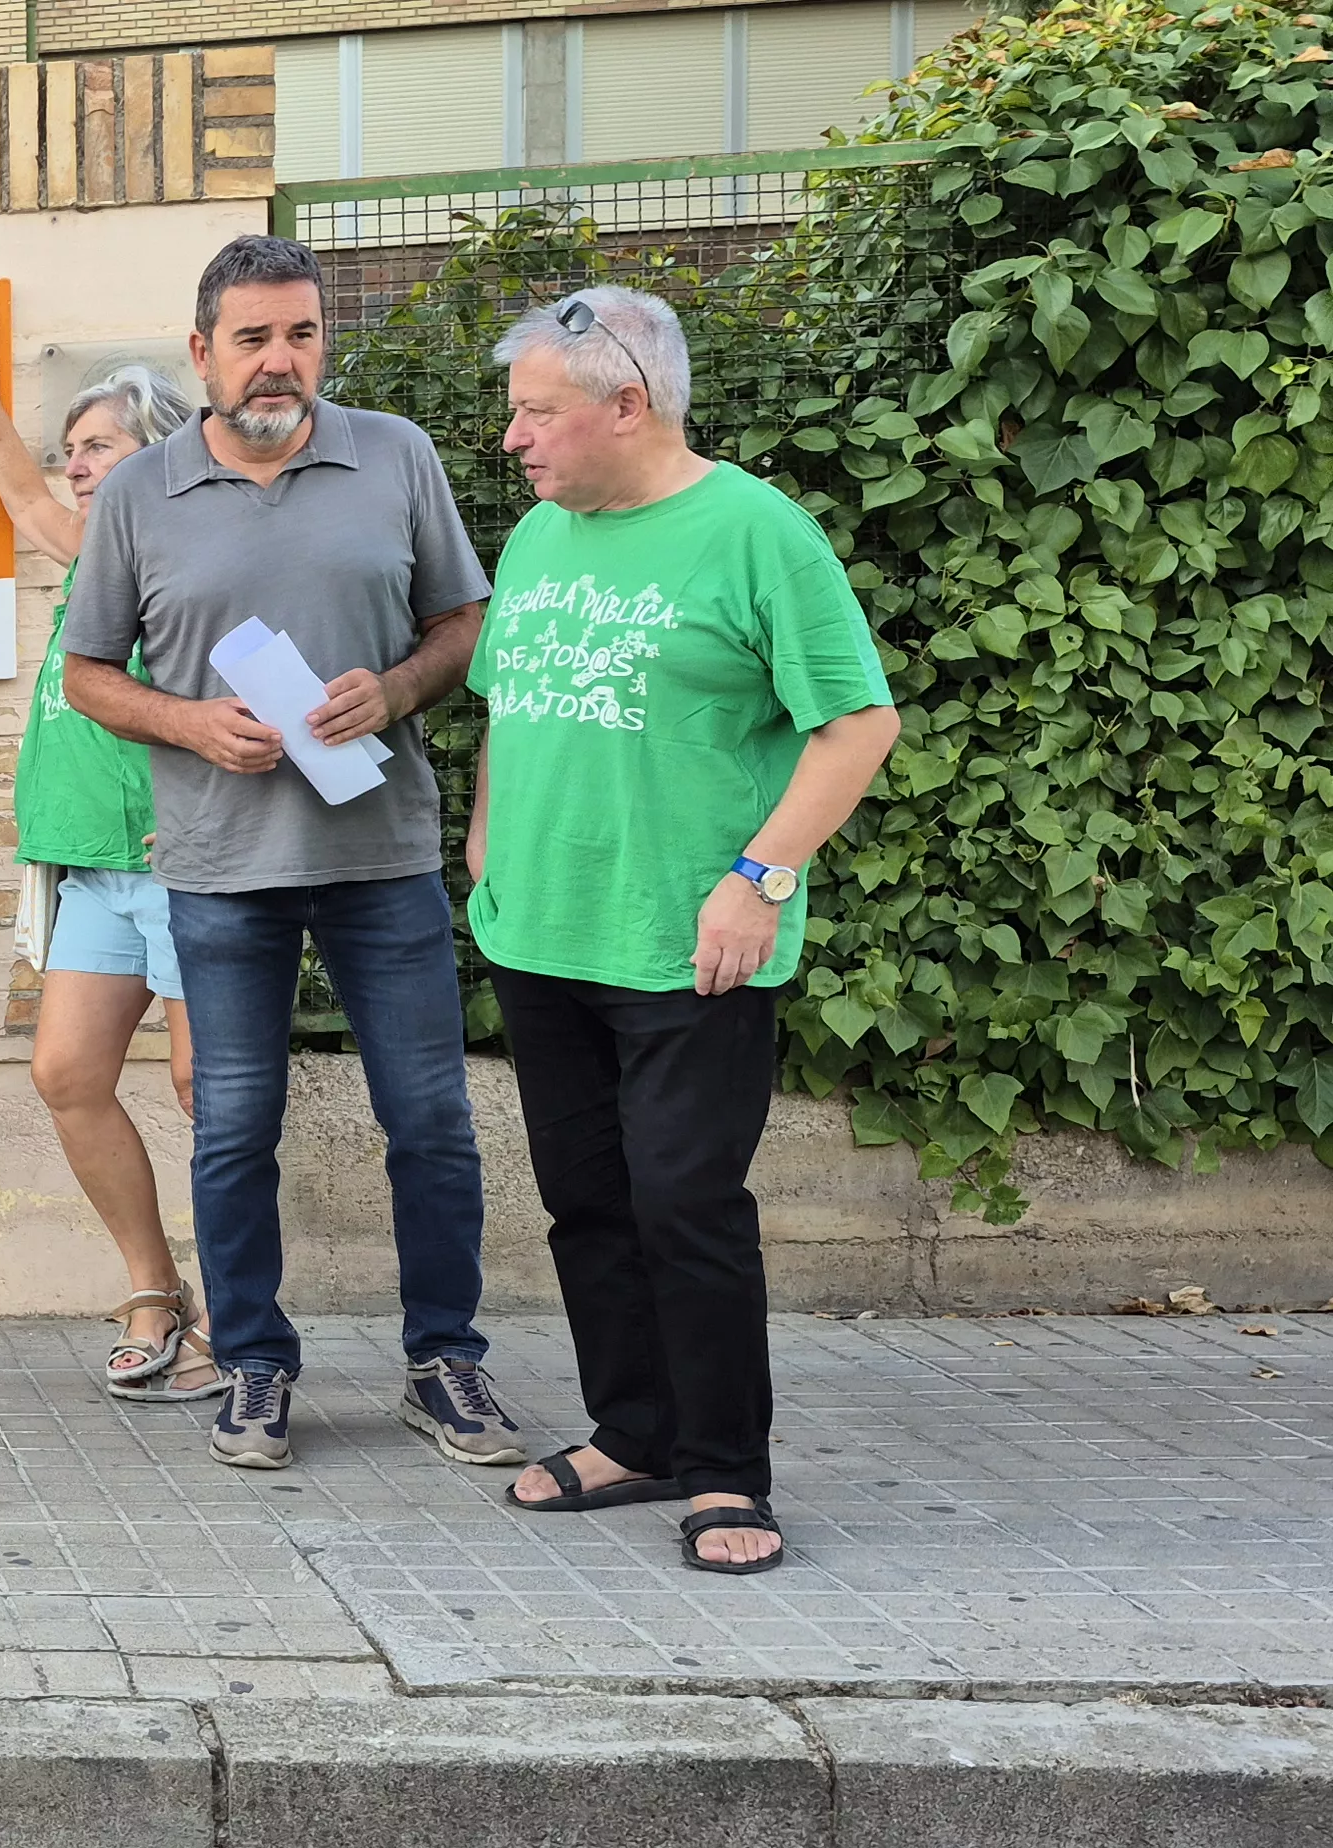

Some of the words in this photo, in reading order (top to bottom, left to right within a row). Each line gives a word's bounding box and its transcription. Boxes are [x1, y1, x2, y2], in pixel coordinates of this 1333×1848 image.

[497, 581, 579, 619] ESCUELA
[496, 646, 528, 673] DE
[540, 645, 634, 677] TOD@S
[542, 691, 647, 731] TOD@S
